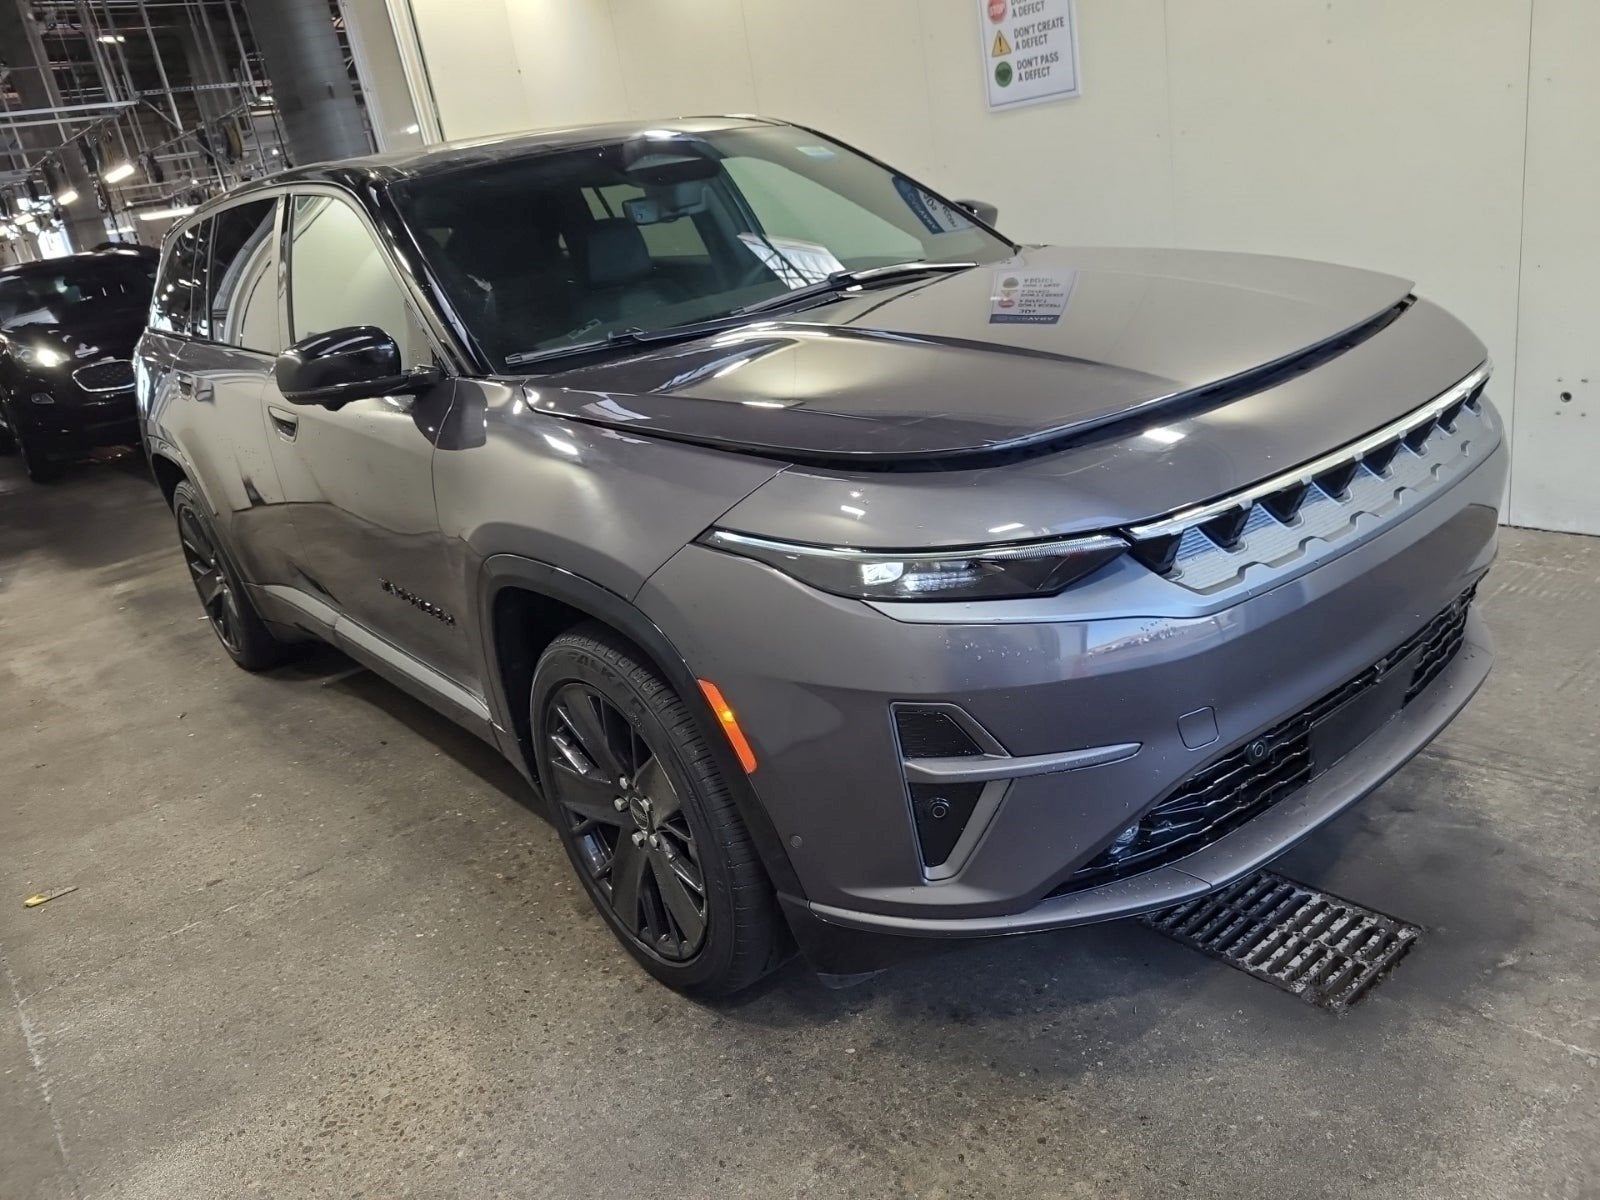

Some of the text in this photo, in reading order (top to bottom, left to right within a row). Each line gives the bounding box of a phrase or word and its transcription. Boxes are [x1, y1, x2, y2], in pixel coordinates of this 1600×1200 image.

[1012, 9, 1017, 18] A
[1018, 1, 1045, 16] DEFECT
[1013, 16, 1065, 39] DON'T CREATE
[1015, 34, 1048, 51] A DEFECT
[1016, 51, 1059, 70] DON'T PASS
[1018, 66, 1051, 82] A DEFECT
